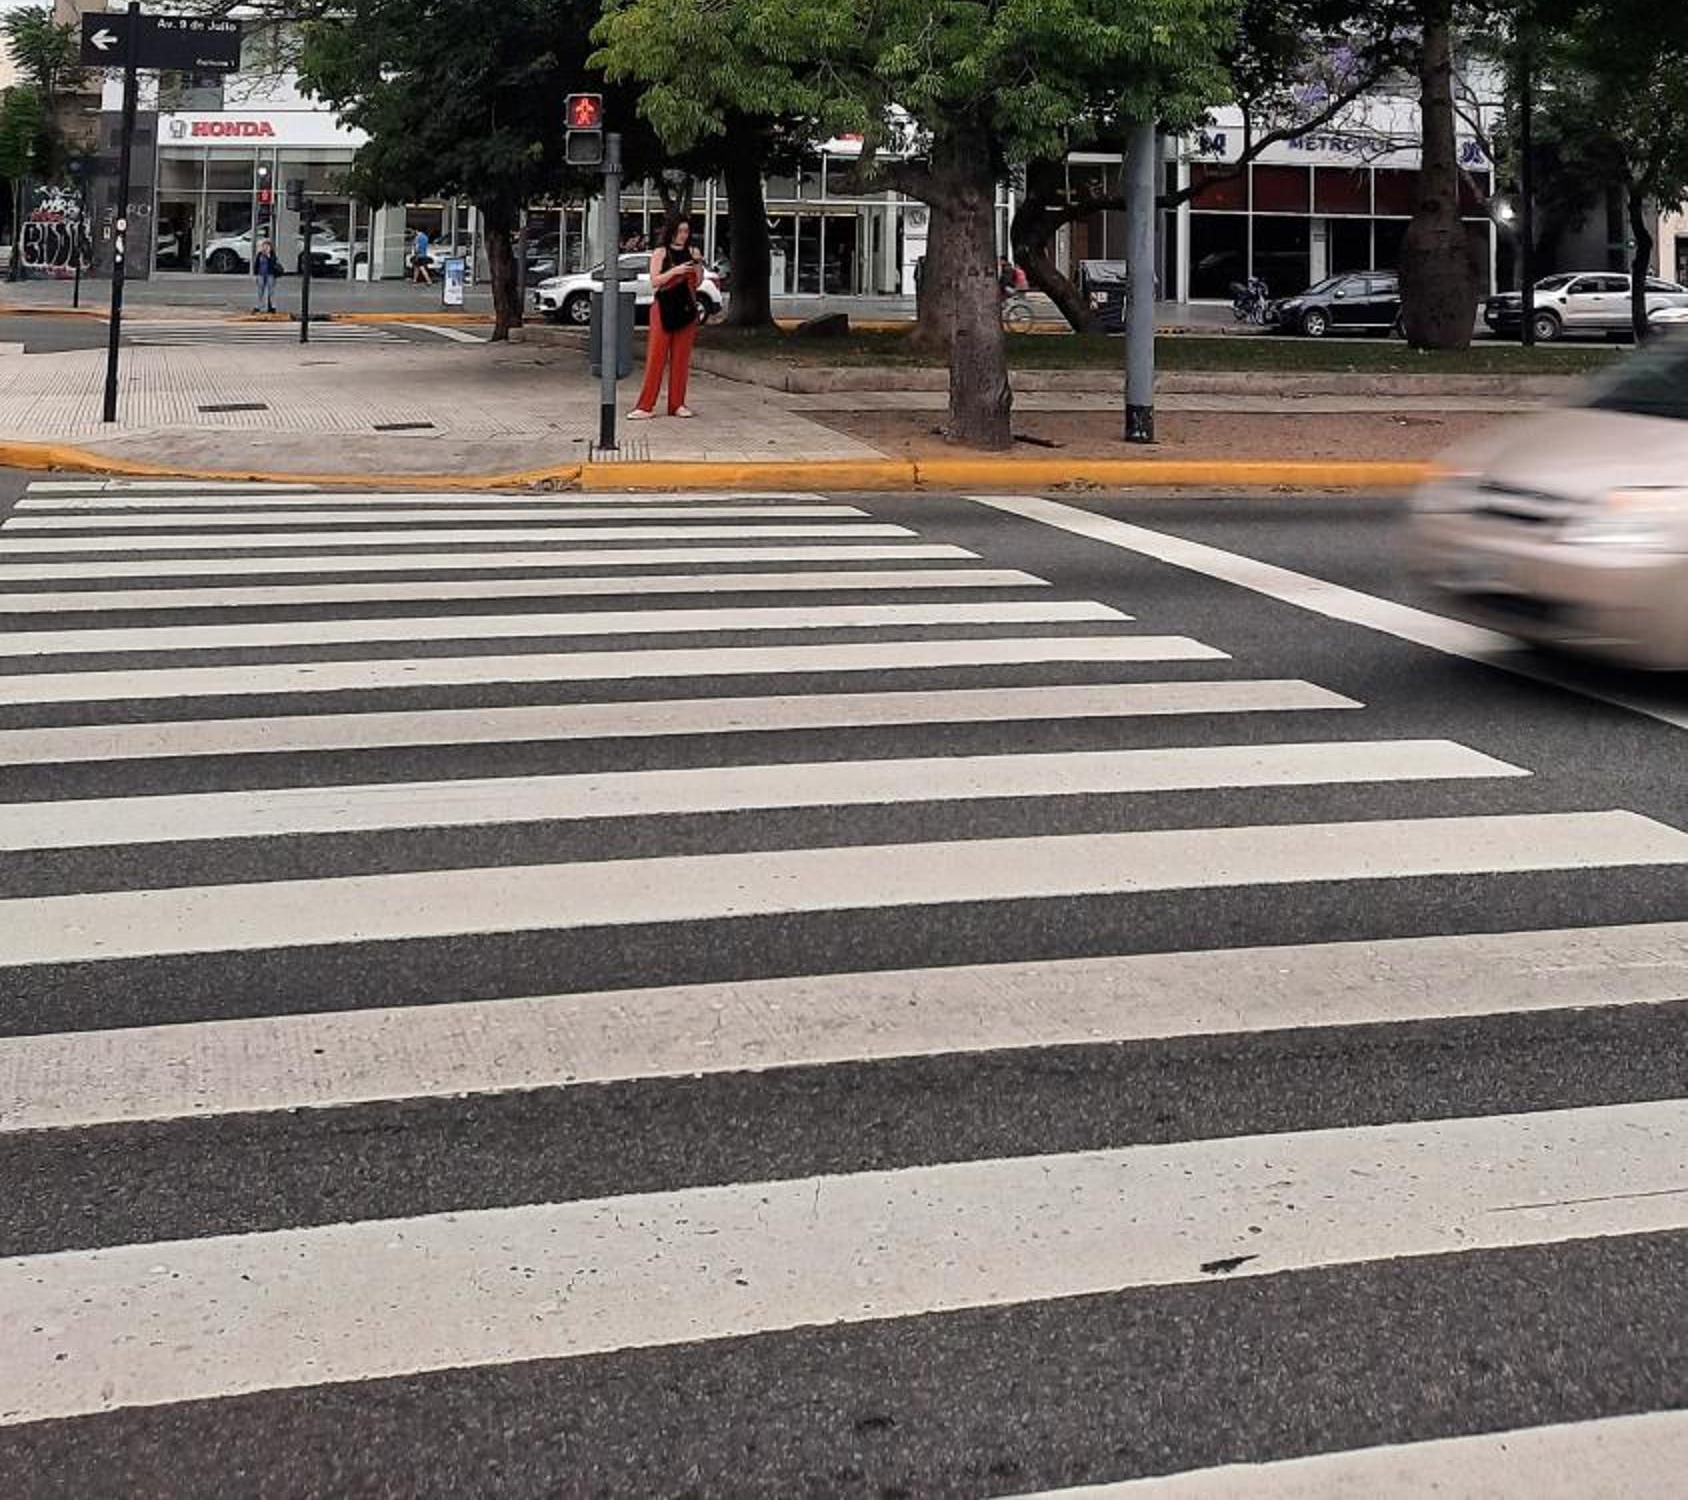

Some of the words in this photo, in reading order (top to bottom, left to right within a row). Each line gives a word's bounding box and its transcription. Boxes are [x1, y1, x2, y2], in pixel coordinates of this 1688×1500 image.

[157, 17, 178, 29] Av.
[179, 19, 188, 29] 9
[189, 20, 205, 31] de
[207, 19, 237, 32] Julio
[191, 121, 276, 137] HONDA
